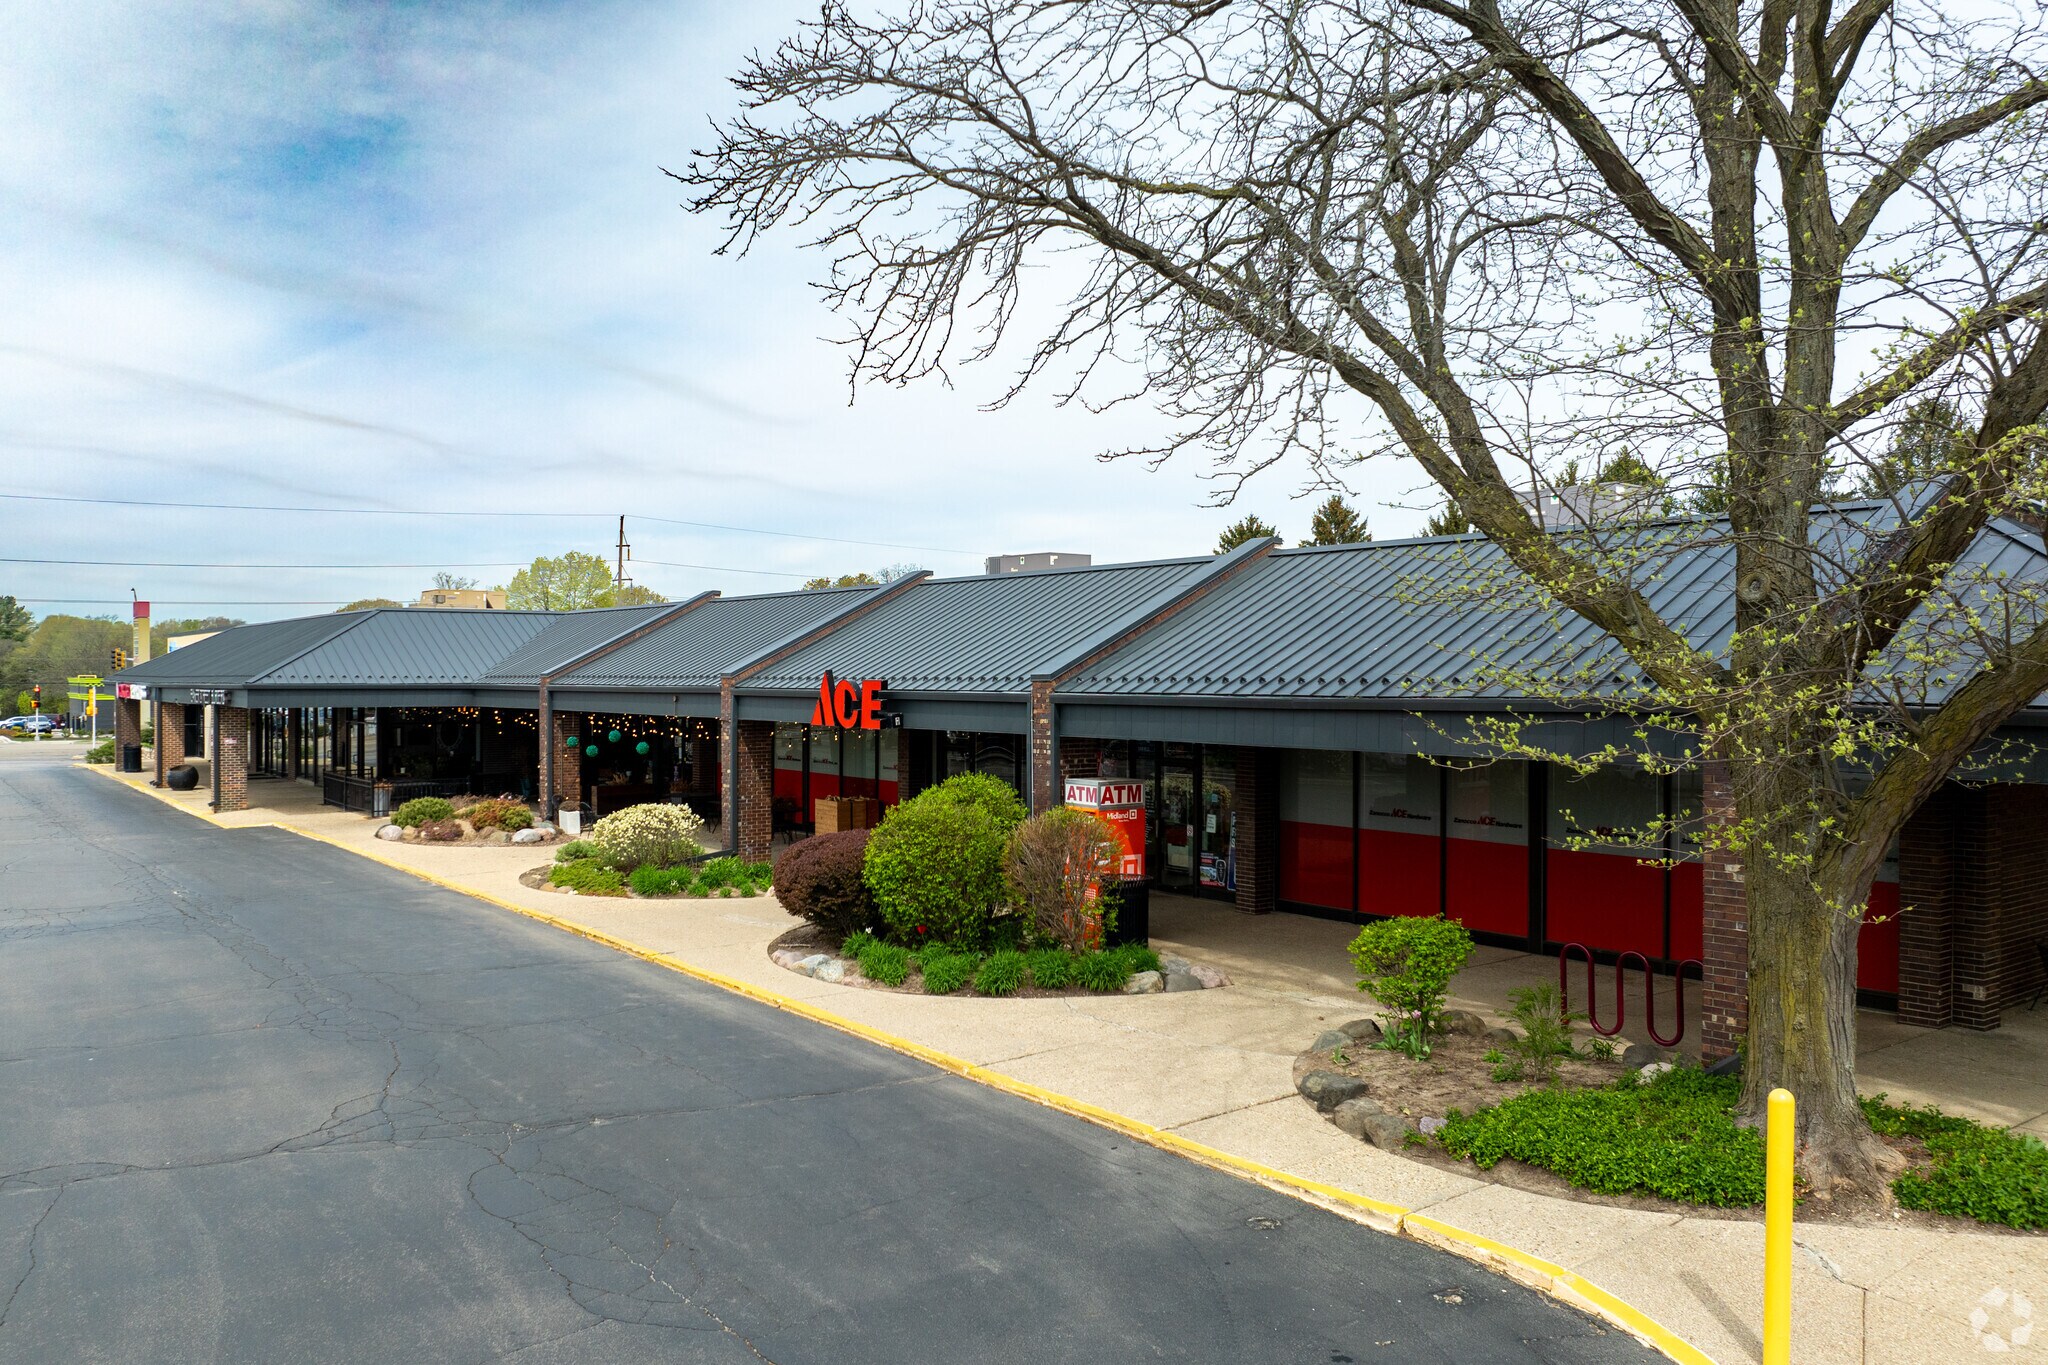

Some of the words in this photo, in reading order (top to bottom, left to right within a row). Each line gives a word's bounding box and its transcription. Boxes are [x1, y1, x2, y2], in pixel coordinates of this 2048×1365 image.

[811, 670, 886, 730] ACE
[1067, 785, 1098, 804] ATM
[1101, 784, 1142, 805] ATM
[1106, 811, 1128, 819] Midland
[1477, 815, 1496, 826] ACE
